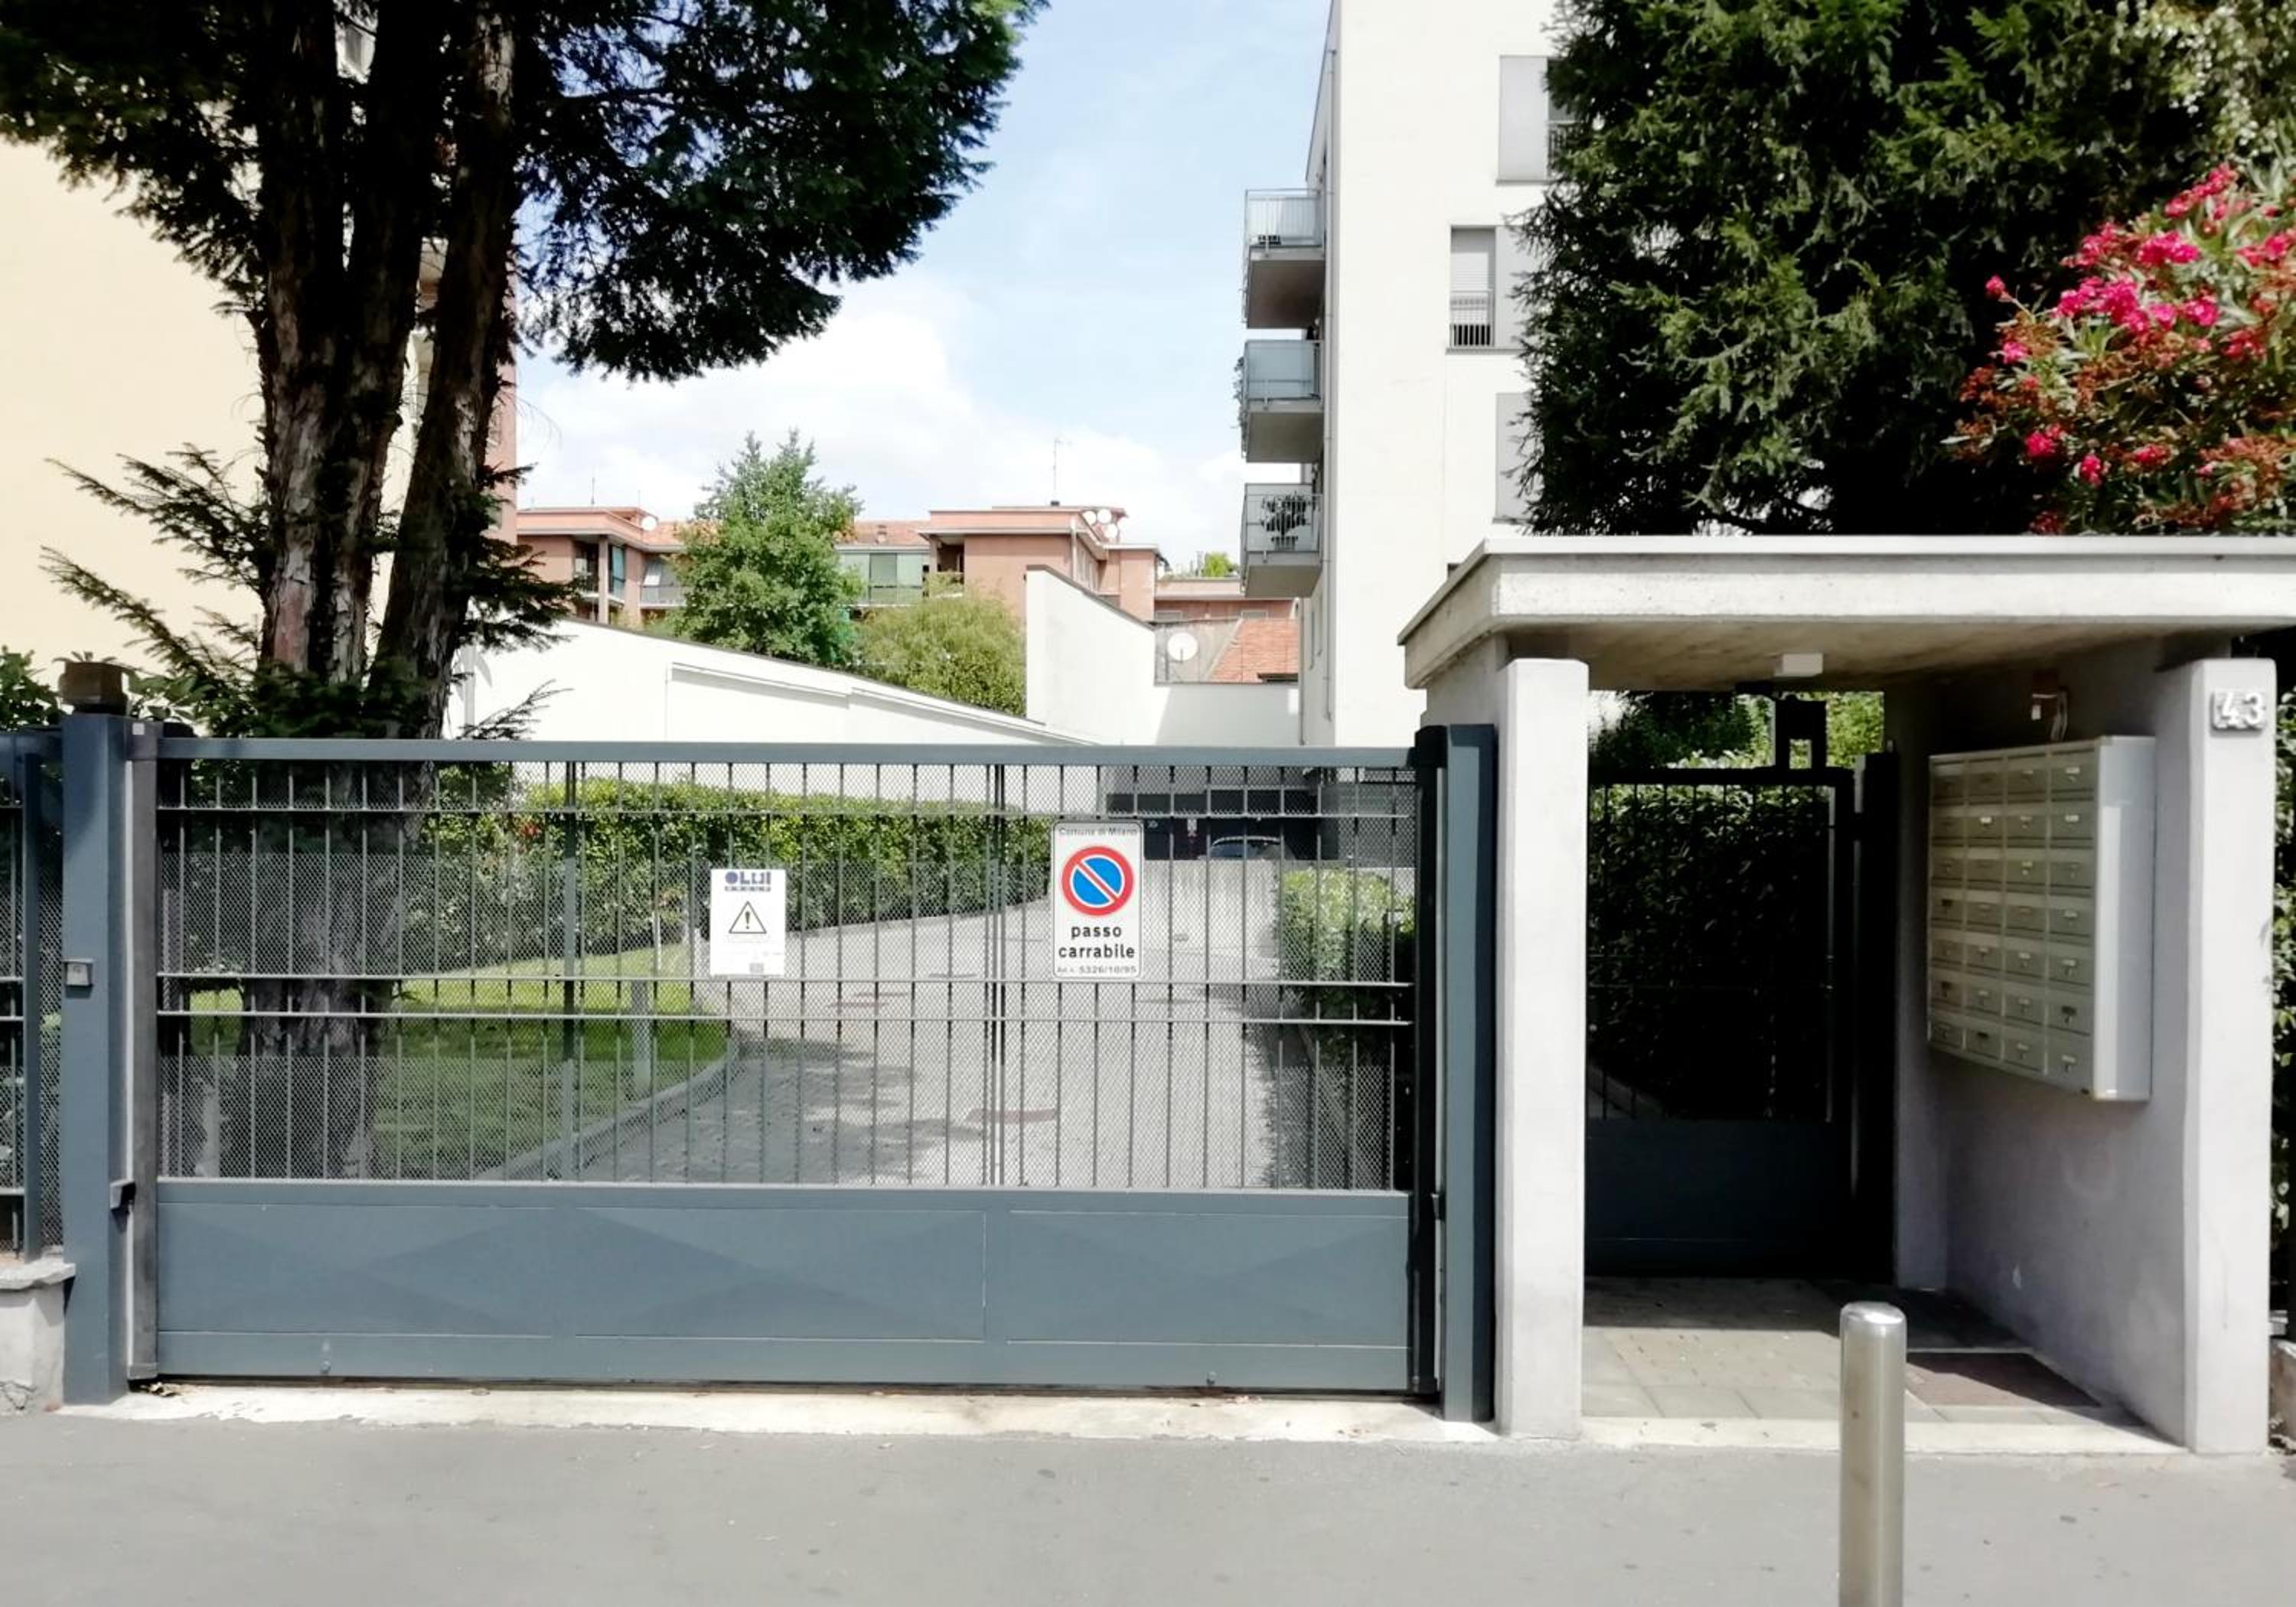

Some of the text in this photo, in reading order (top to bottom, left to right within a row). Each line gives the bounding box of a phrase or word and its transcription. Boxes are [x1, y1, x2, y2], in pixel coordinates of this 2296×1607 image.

[2220, 691, 2263, 726] 43
[1071, 925, 1122, 940] passo
[1058, 944, 1135, 958] carrabile
